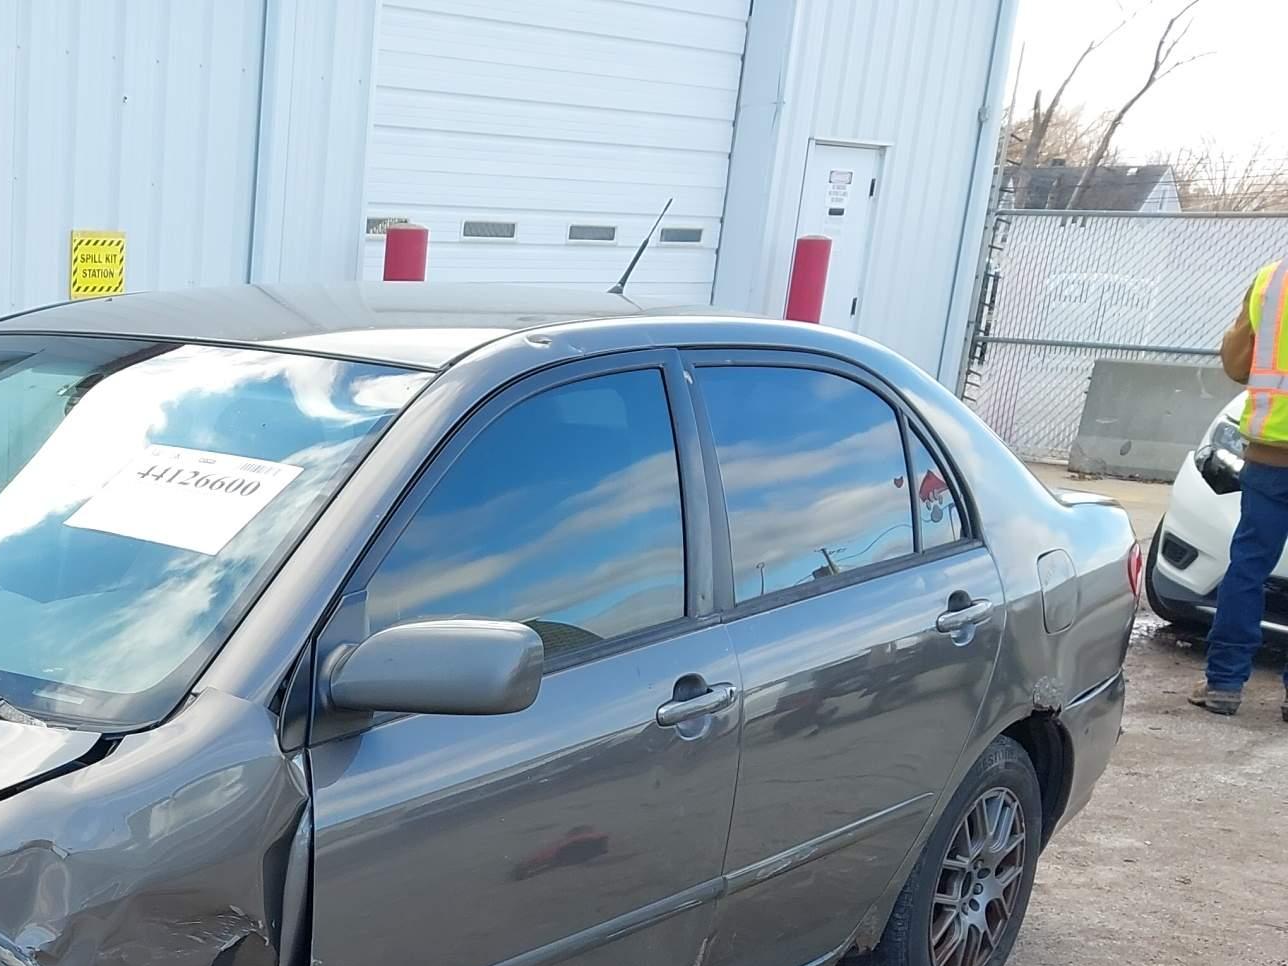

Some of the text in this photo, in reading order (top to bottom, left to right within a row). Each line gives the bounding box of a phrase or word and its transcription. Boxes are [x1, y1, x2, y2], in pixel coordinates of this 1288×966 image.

[80, 254, 117, 264] SPILL KIT
[82, 268, 114, 278] STATION
[136, 464, 261, 497] 44126600
